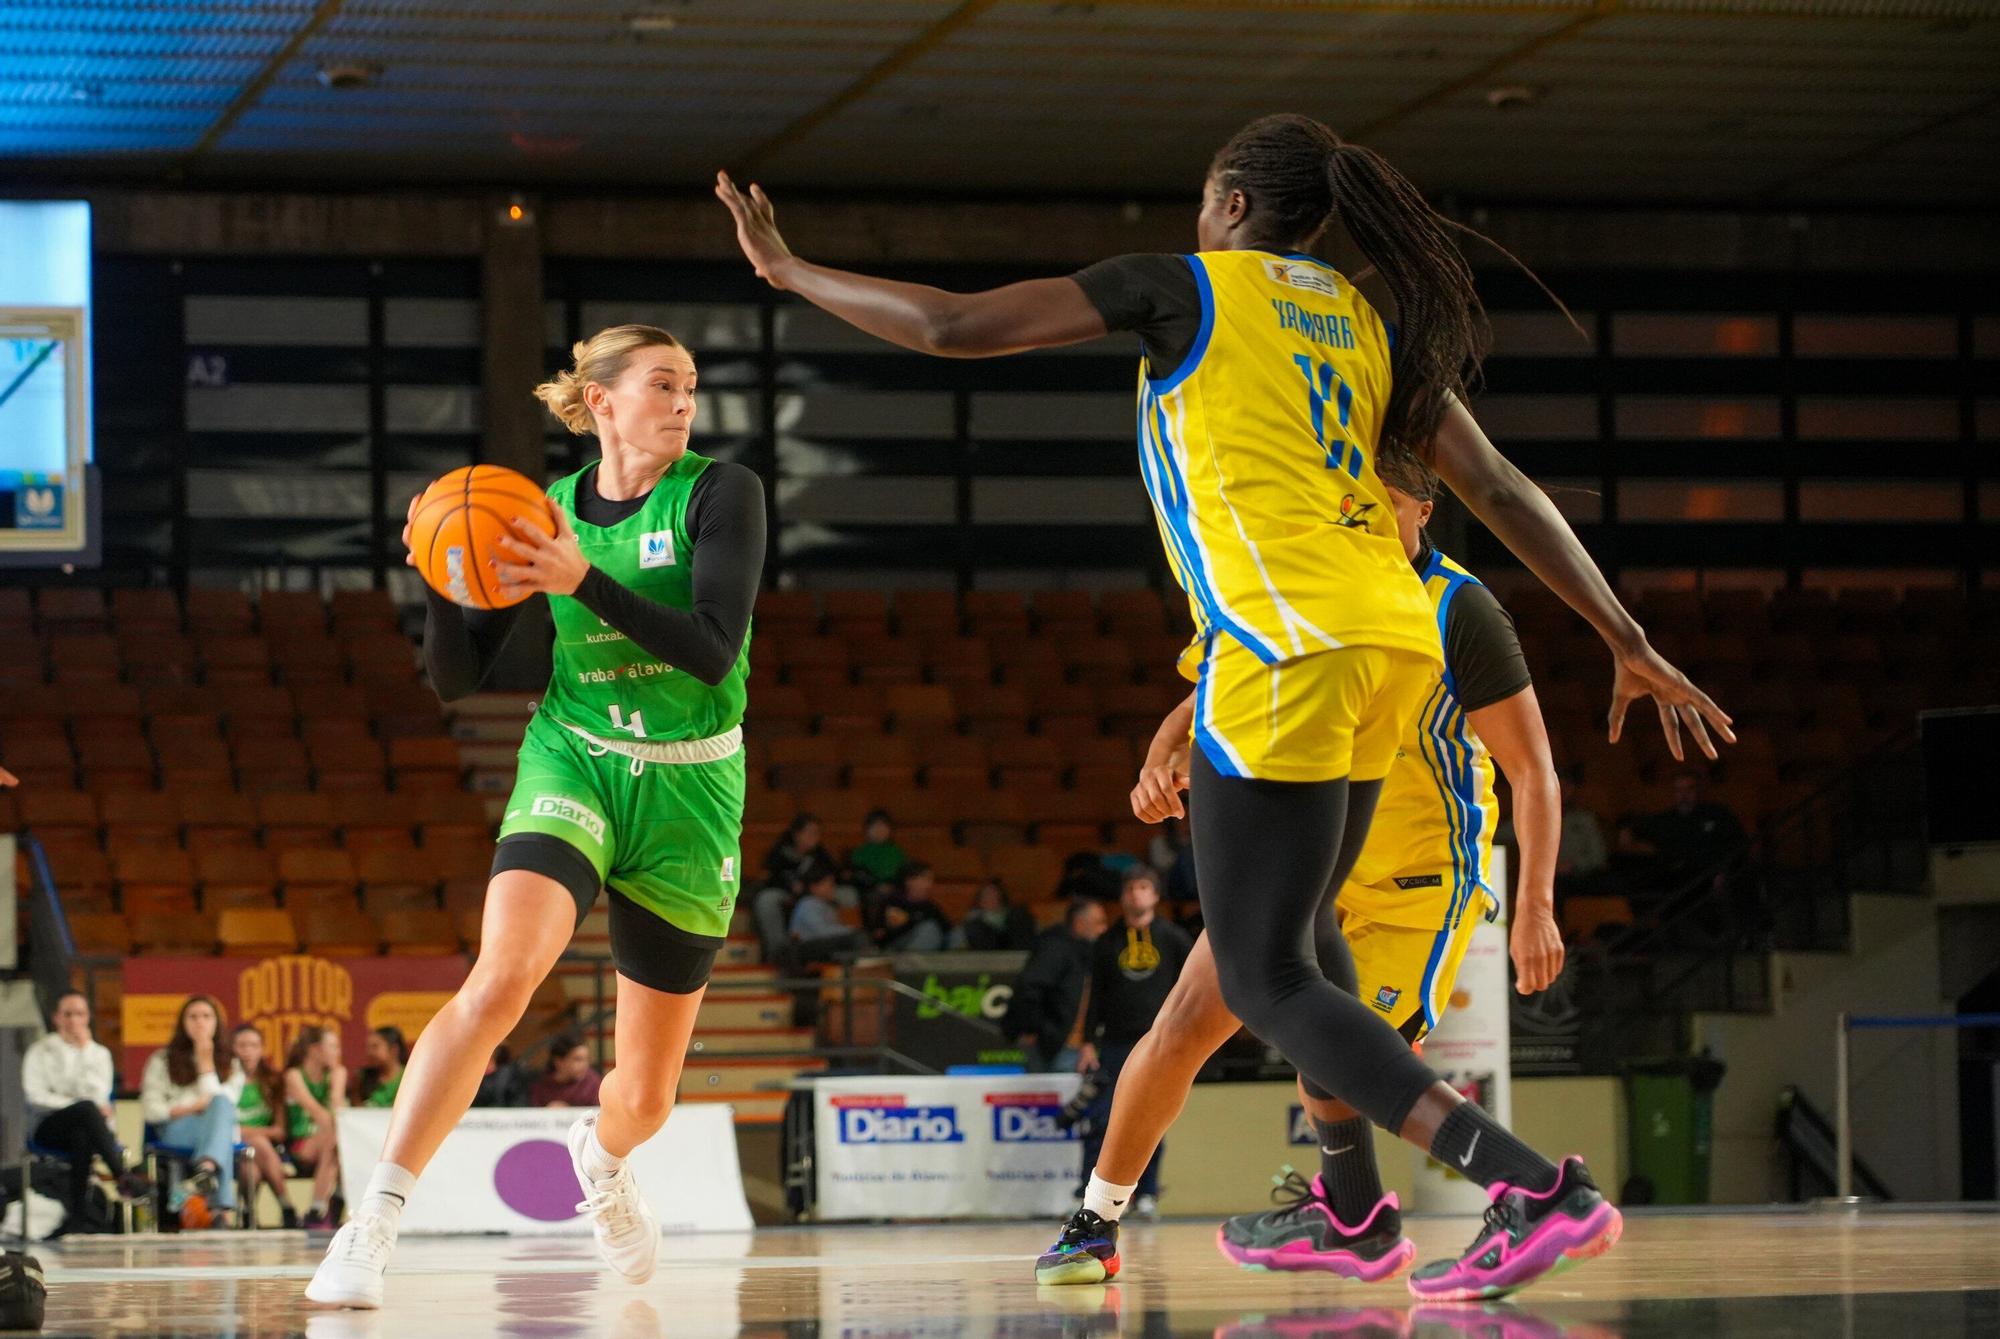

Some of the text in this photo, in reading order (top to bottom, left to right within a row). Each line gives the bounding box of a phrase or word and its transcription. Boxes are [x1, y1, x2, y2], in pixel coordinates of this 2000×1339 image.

[188, 355, 226, 383] A2
[586, 630, 628, 643] kutxab
[578, 663, 674, 684] araba álava
[608, 704, 648, 738] 4
[538, 799, 601, 835] Diario
[239, 955, 352, 1021] DOTTOR
[845, 1108, 954, 1142] Diario
